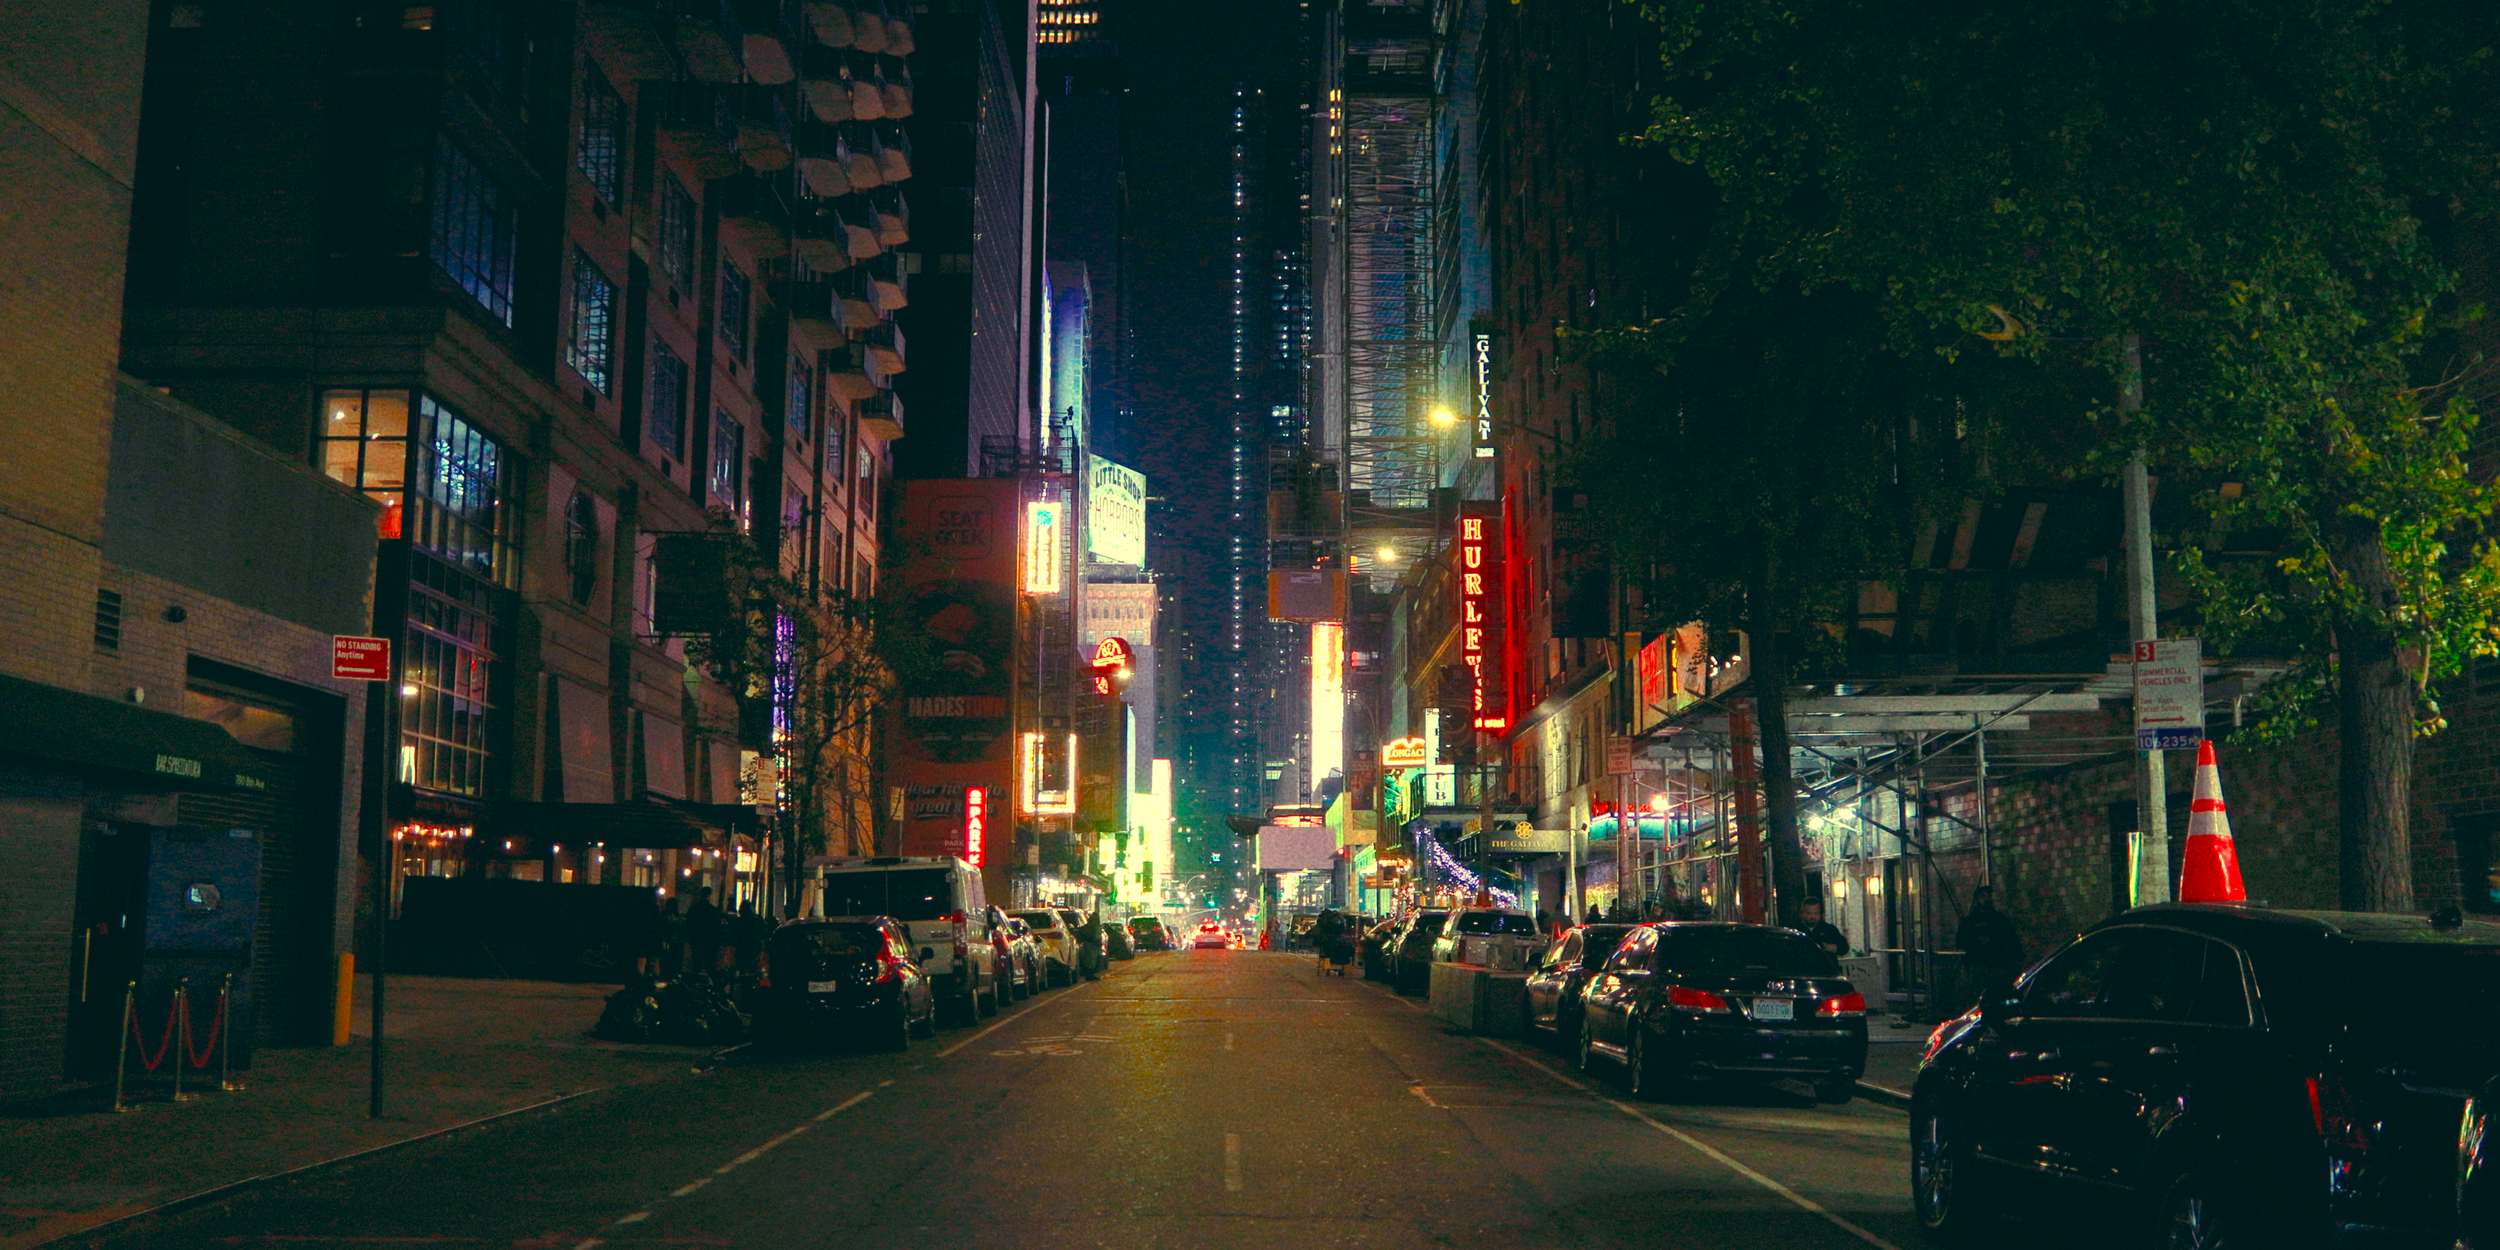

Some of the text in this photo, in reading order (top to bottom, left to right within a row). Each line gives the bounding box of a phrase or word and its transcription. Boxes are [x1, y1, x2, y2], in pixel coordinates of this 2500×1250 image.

[1476, 340, 1491, 440] GALLIVANT
[1095, 466, 1141, 505] LITTLE SHOP
[1095, 494, 1140, 543] HORRORS
[337, 640, 382, 651] NO STANDING
[2140, 643, 2150, 661] 3
[336, 650, 365, 660] Anytime
[2139, 667, 2187, 677] COMMERCIAL
[2139, 675, 2192, 686] VEHICLES ONLY
[1388, 748, 1425, 758] LONGAC
[1435, 772, 1447, 800] PUB
[967, 806, 982, 853] PARK
[1491, 840, 1559, 848] THE GALLIVANT
